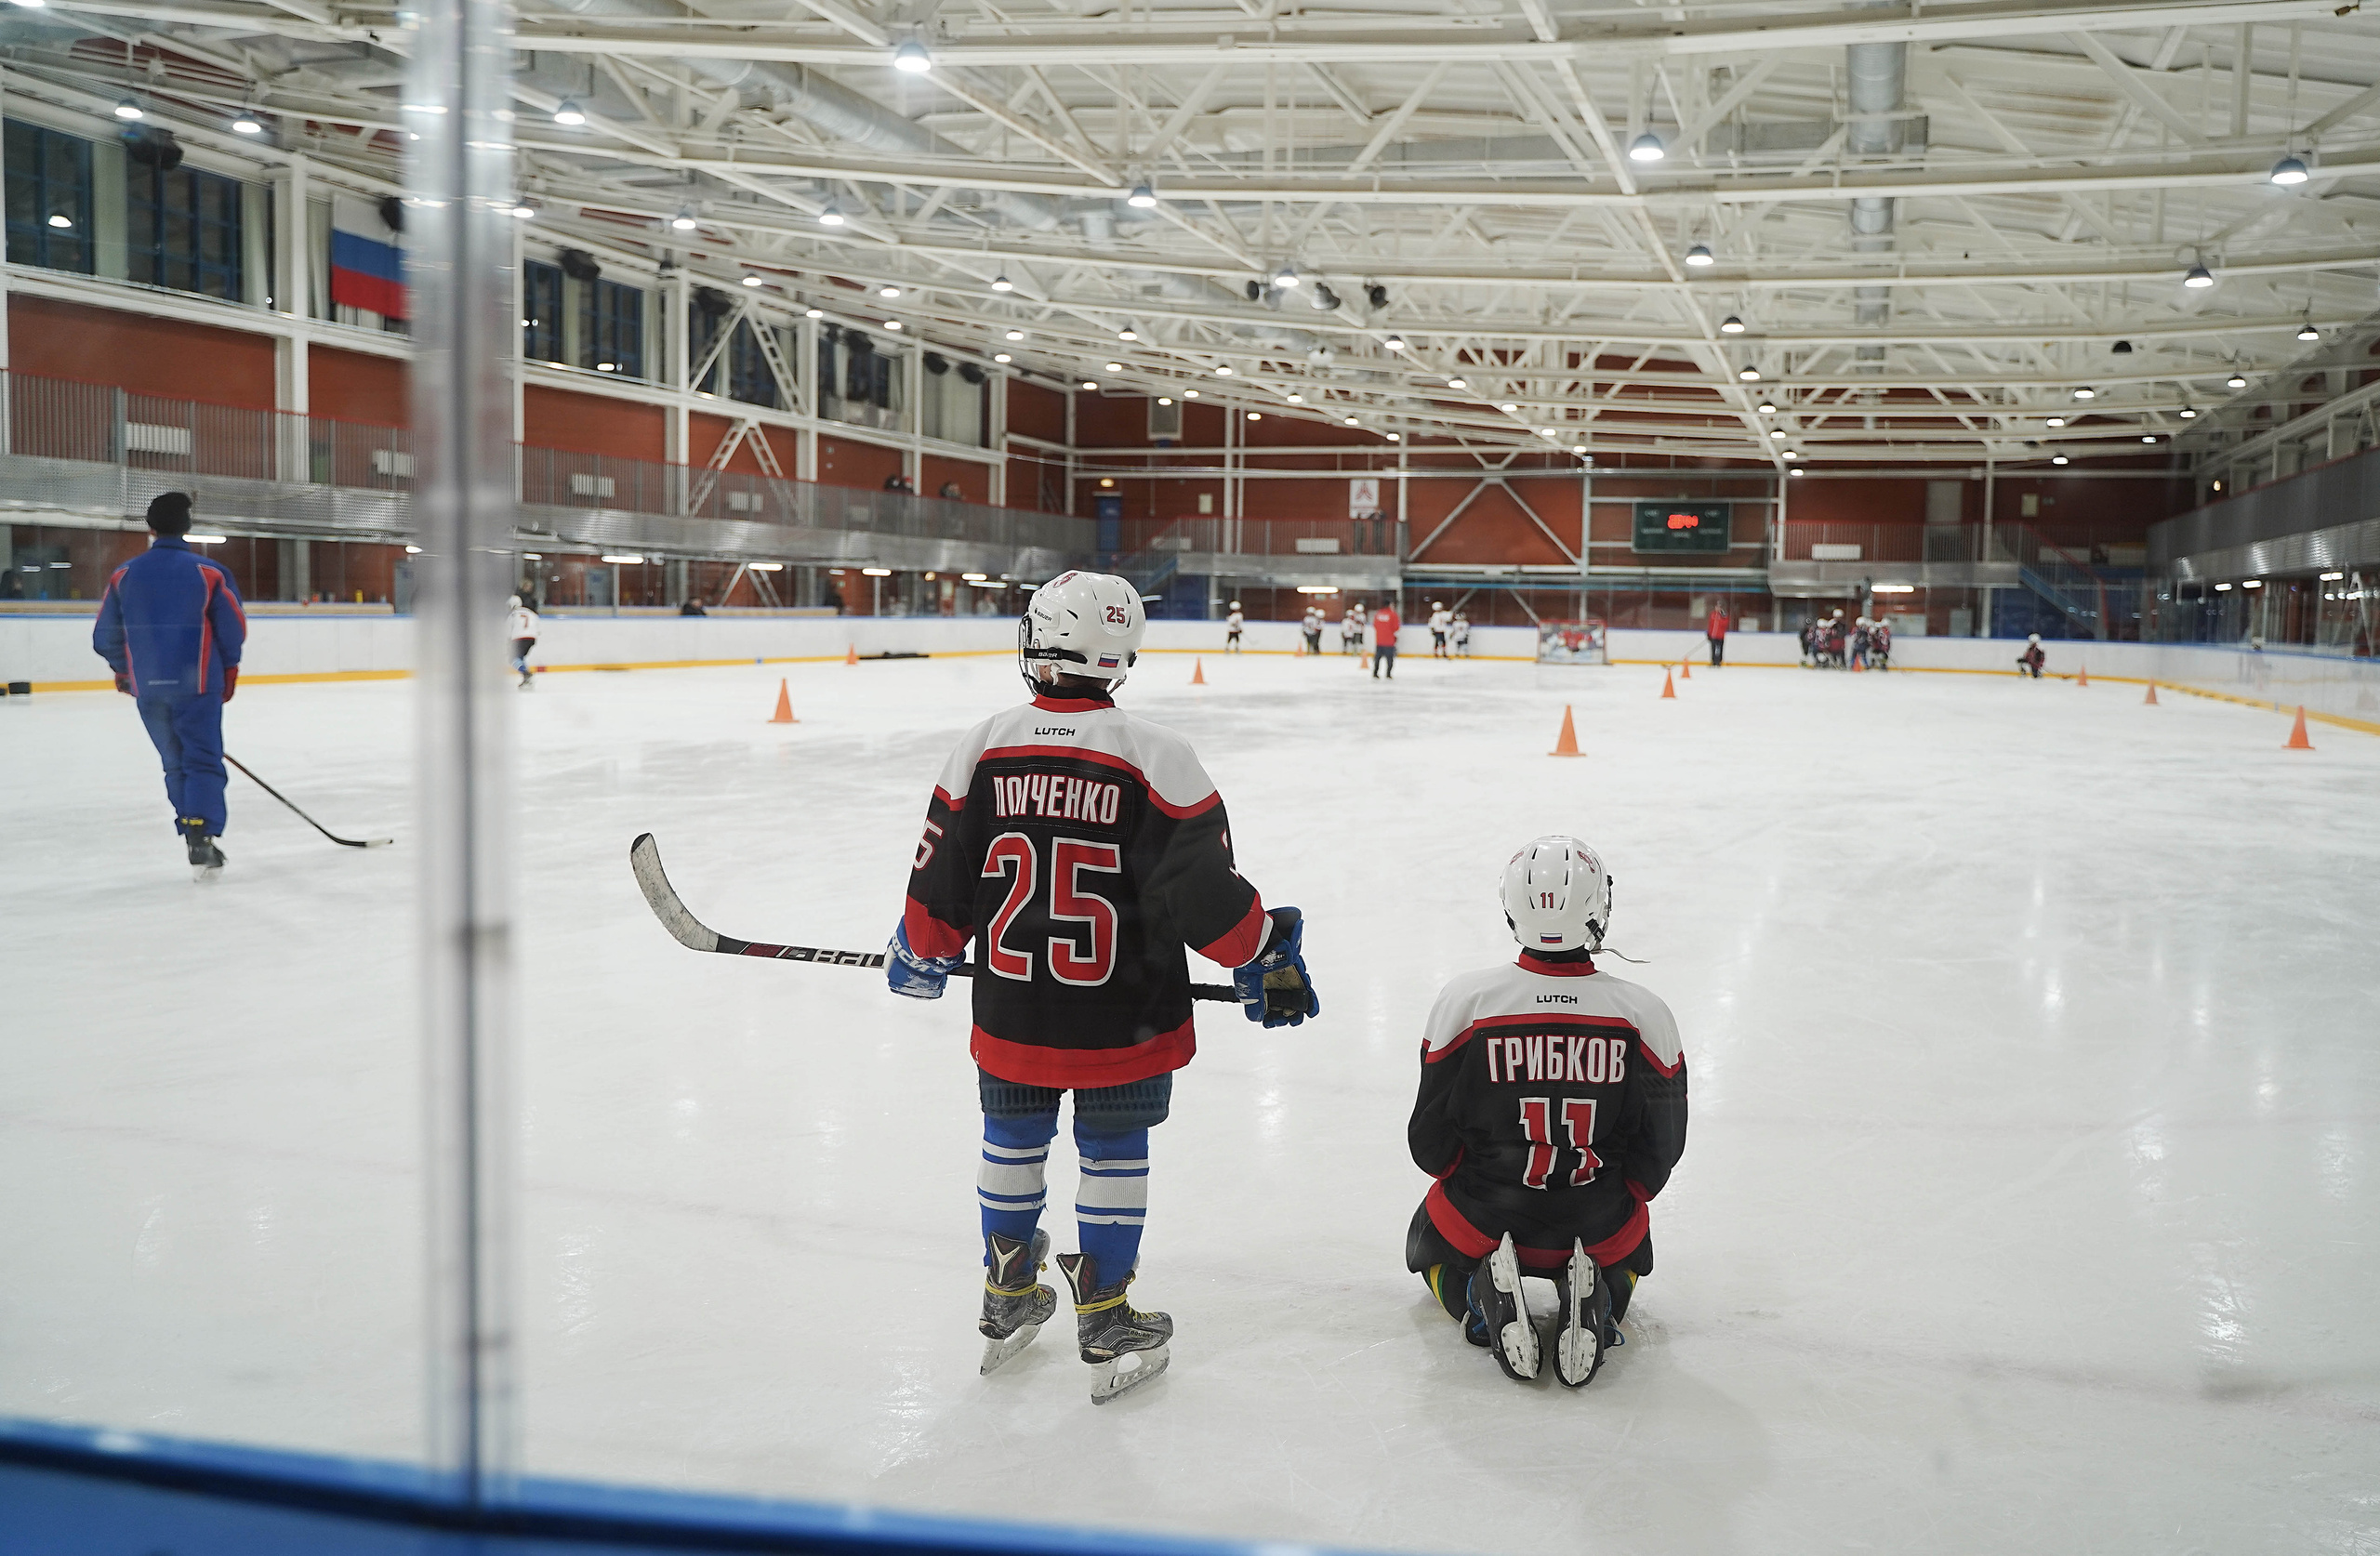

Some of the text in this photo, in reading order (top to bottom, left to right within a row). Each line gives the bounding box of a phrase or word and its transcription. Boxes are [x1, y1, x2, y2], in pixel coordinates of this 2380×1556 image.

[1106, 606, 1125, 624] 25
[1035, 727, 1076, 736] LUTCH
[1540, 891, 1554, 908] 11
[981, 832, 1122, 987] 25
[1537, 995, 1578, 1004] LUTCH
[1487, 1035, 1627, 1085] ГРИБКОВ
[1518, 1097, 1604, 1191] 11
